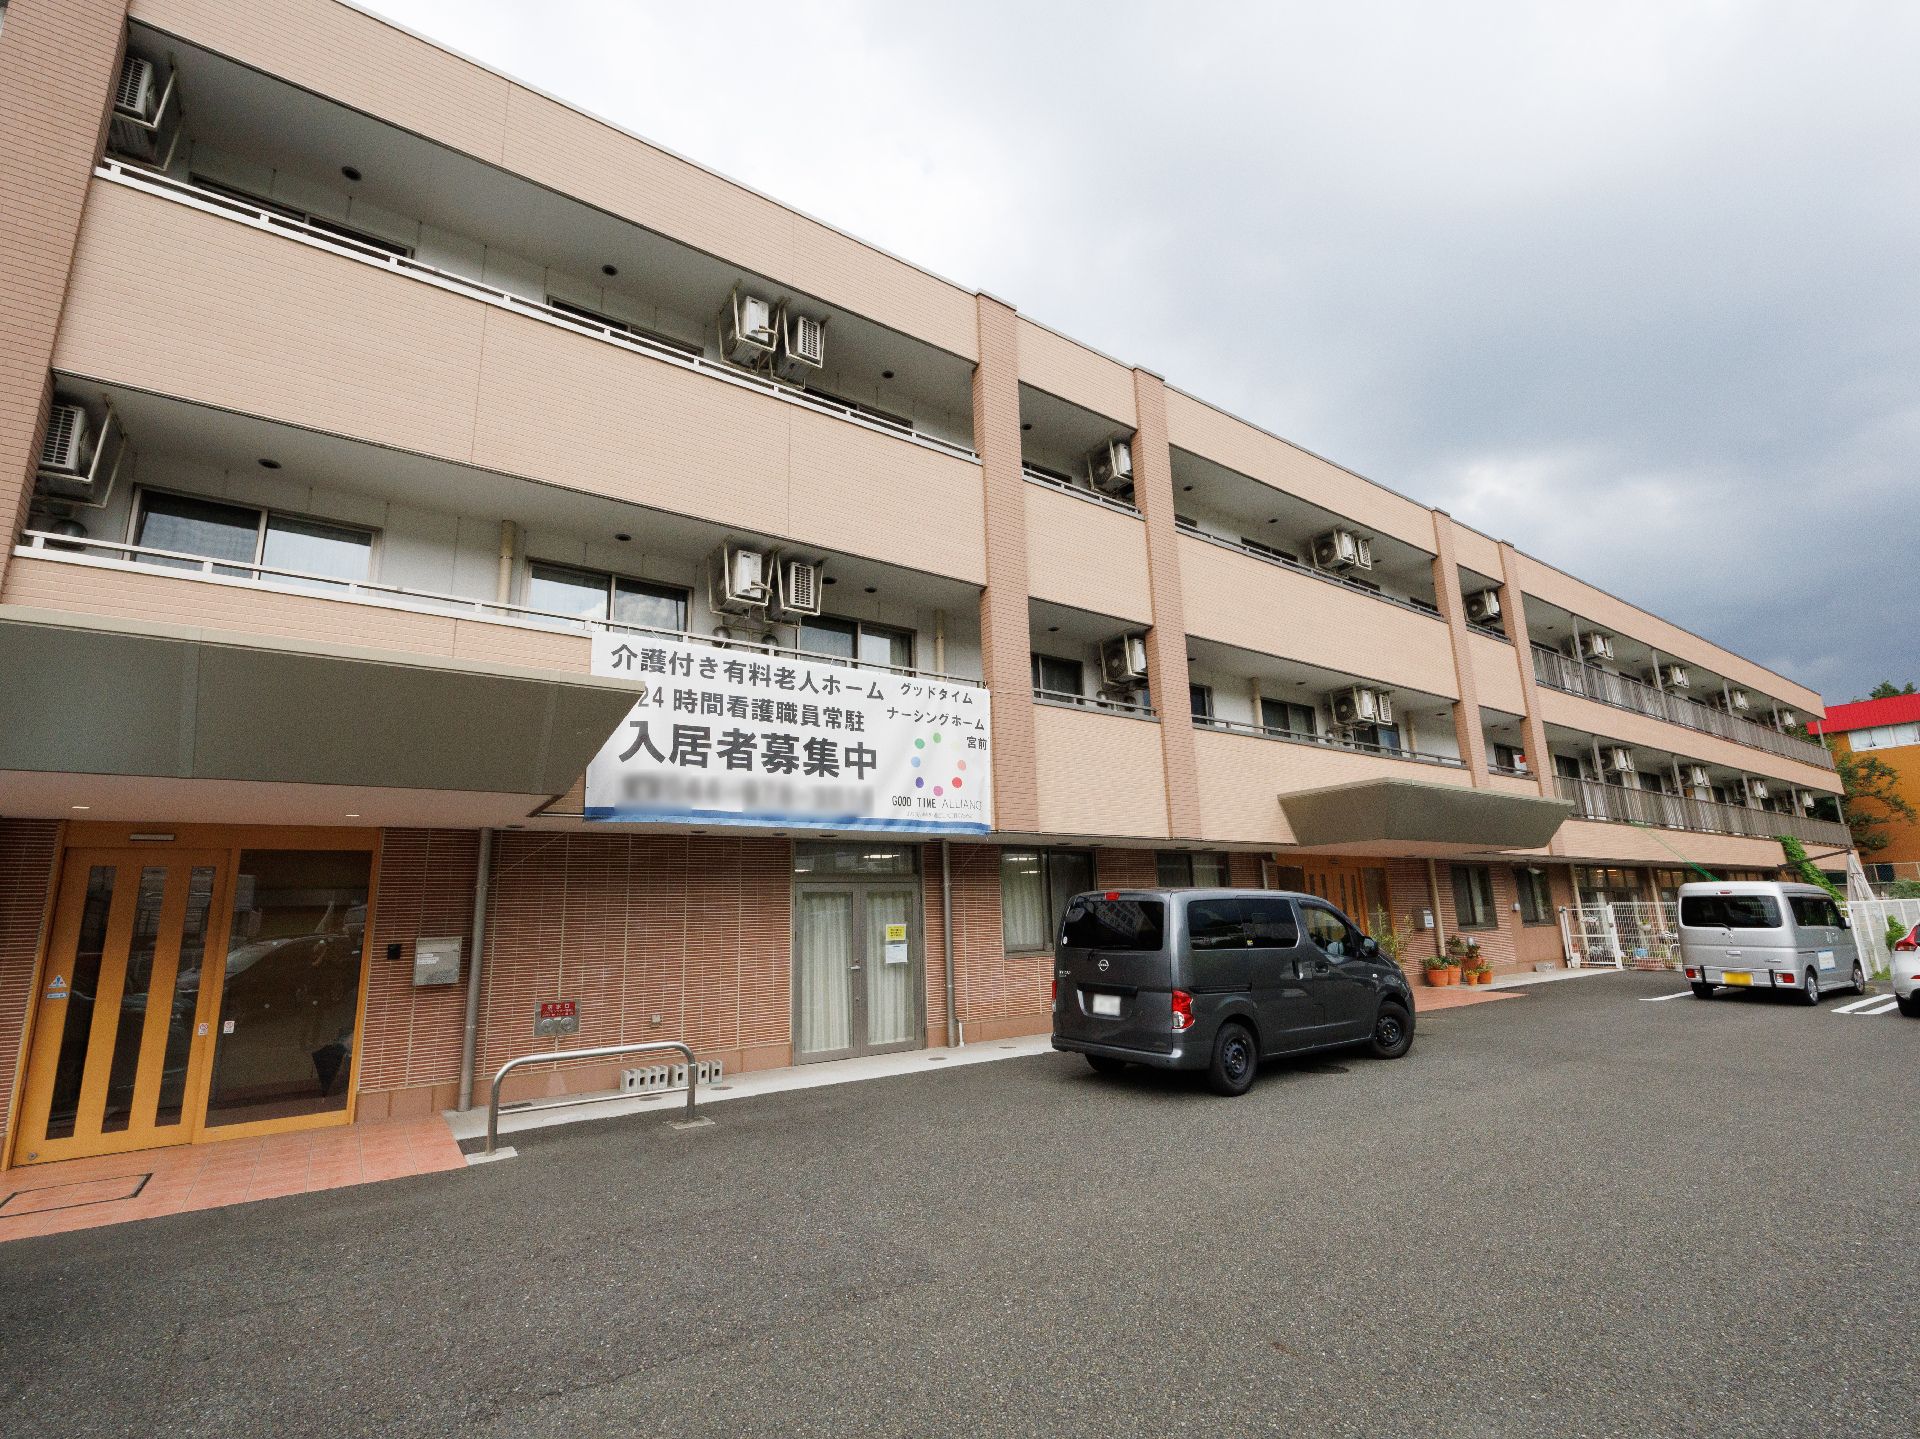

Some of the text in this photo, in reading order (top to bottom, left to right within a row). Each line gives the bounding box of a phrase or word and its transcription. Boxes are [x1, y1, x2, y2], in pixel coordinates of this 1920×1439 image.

[611, 643, 885, 701] 介護付き有料老人ホーム
[900, 682, 973, 705] グッドタイム
[886, 706, 985, 731] ナーシングホーム
[618, 720, 878, 780] 入居者募集中
[966, 735, 988, 751] 宮前
[891, 795, 912, 807] GOOD
[917, 797, 937, 809] TIME
